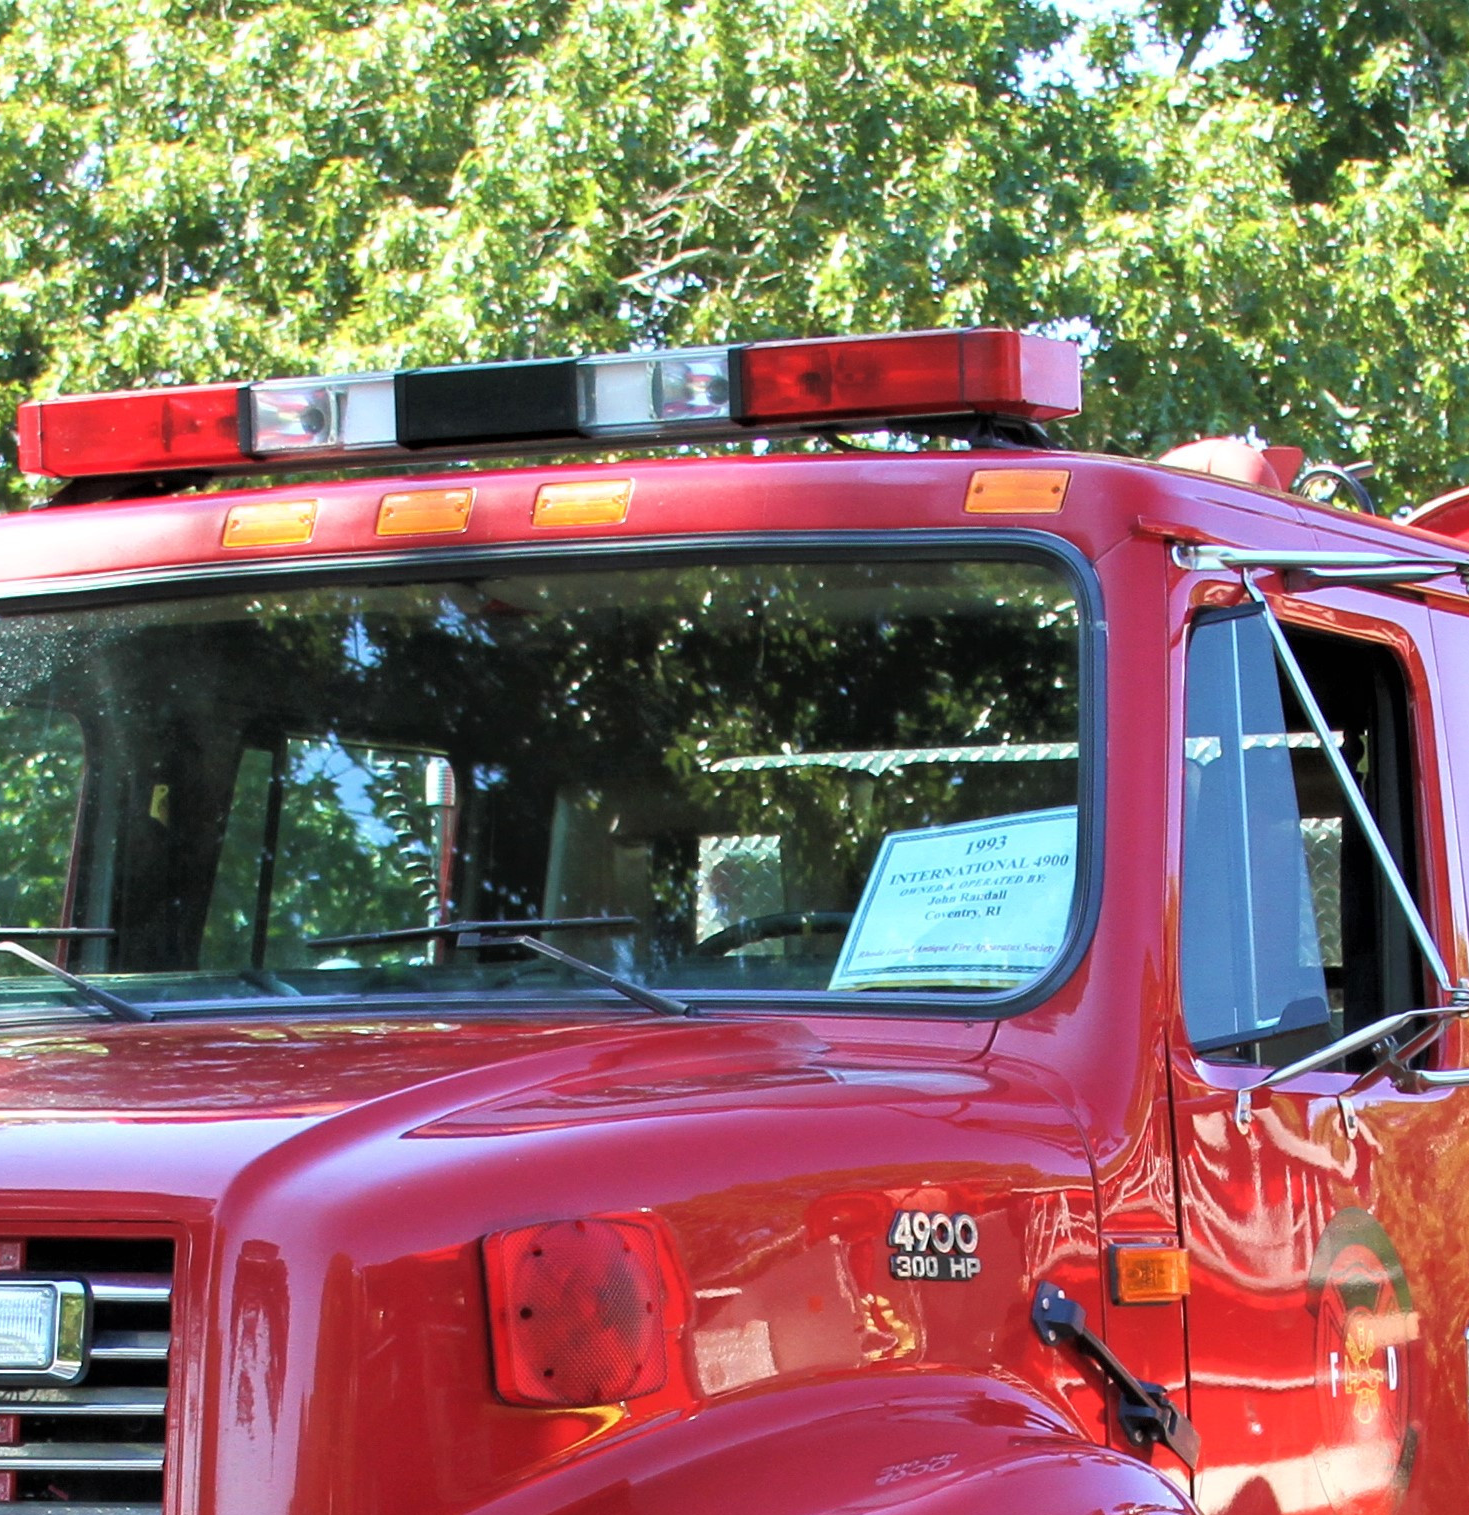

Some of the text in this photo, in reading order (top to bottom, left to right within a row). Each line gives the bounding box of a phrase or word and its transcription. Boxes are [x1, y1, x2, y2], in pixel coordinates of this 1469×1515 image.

[966, 835, 1008, 855] 1993
[889, 854, 1069, 886] INTERNATIONAL 4900
[899, 884, 944, 897] OWNED
[959, 875, 1023, 889] OPERATED
[1026, 874, 1046, 884] BY:
[927, 894, 956, 906] John
[924, 906, 1002, 920] Coventry, RI
[916, 944, 951, 954] Antique
[952, 943, 973, 952] Fire
[1023, 943, 1057, 955] Society
[890, 1210, 978, 1254] 4900
[895, 1255, 981, 1279] 300 HP
[1330, 1346, 1398, 1398] F D
